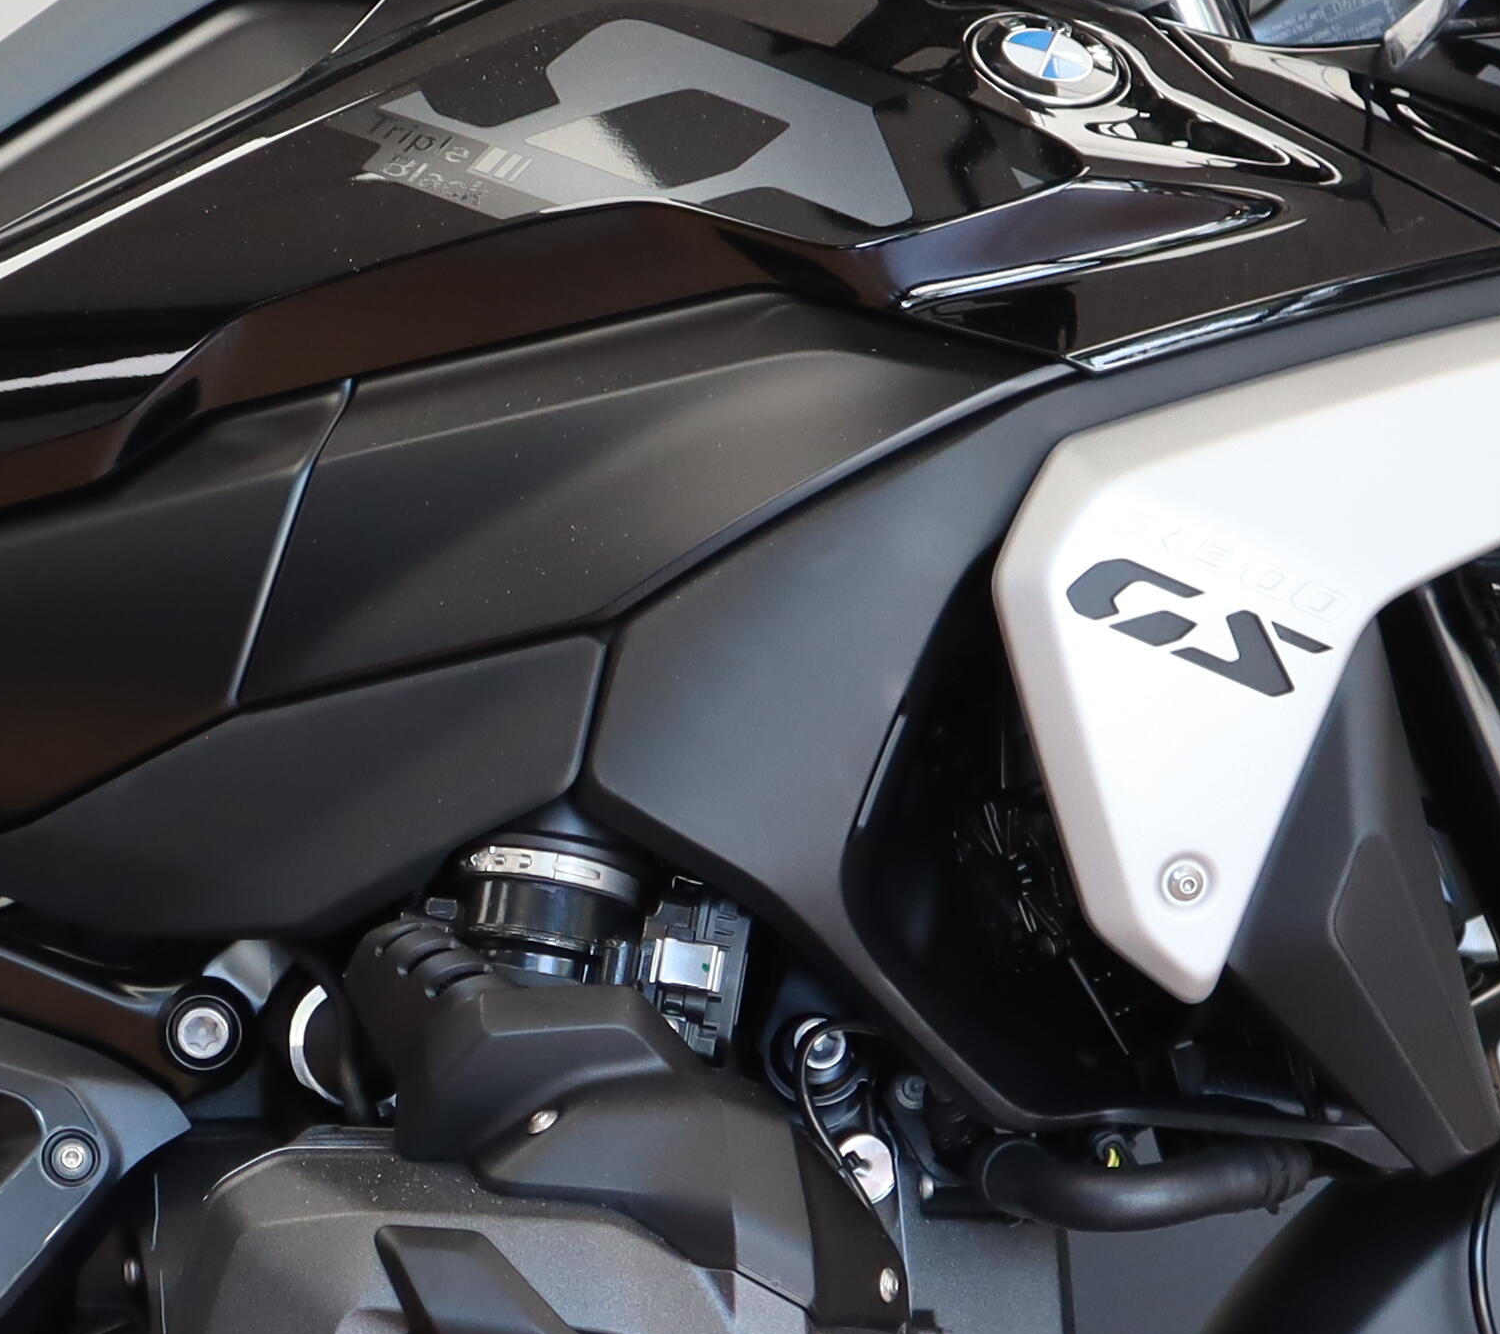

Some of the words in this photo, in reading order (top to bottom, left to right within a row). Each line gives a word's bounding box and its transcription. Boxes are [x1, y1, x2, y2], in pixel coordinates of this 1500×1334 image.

[362, 112, 471, 165] Triple
[381, 155, 490, 208] Black
[1065, 557, 1334, 698] GS
